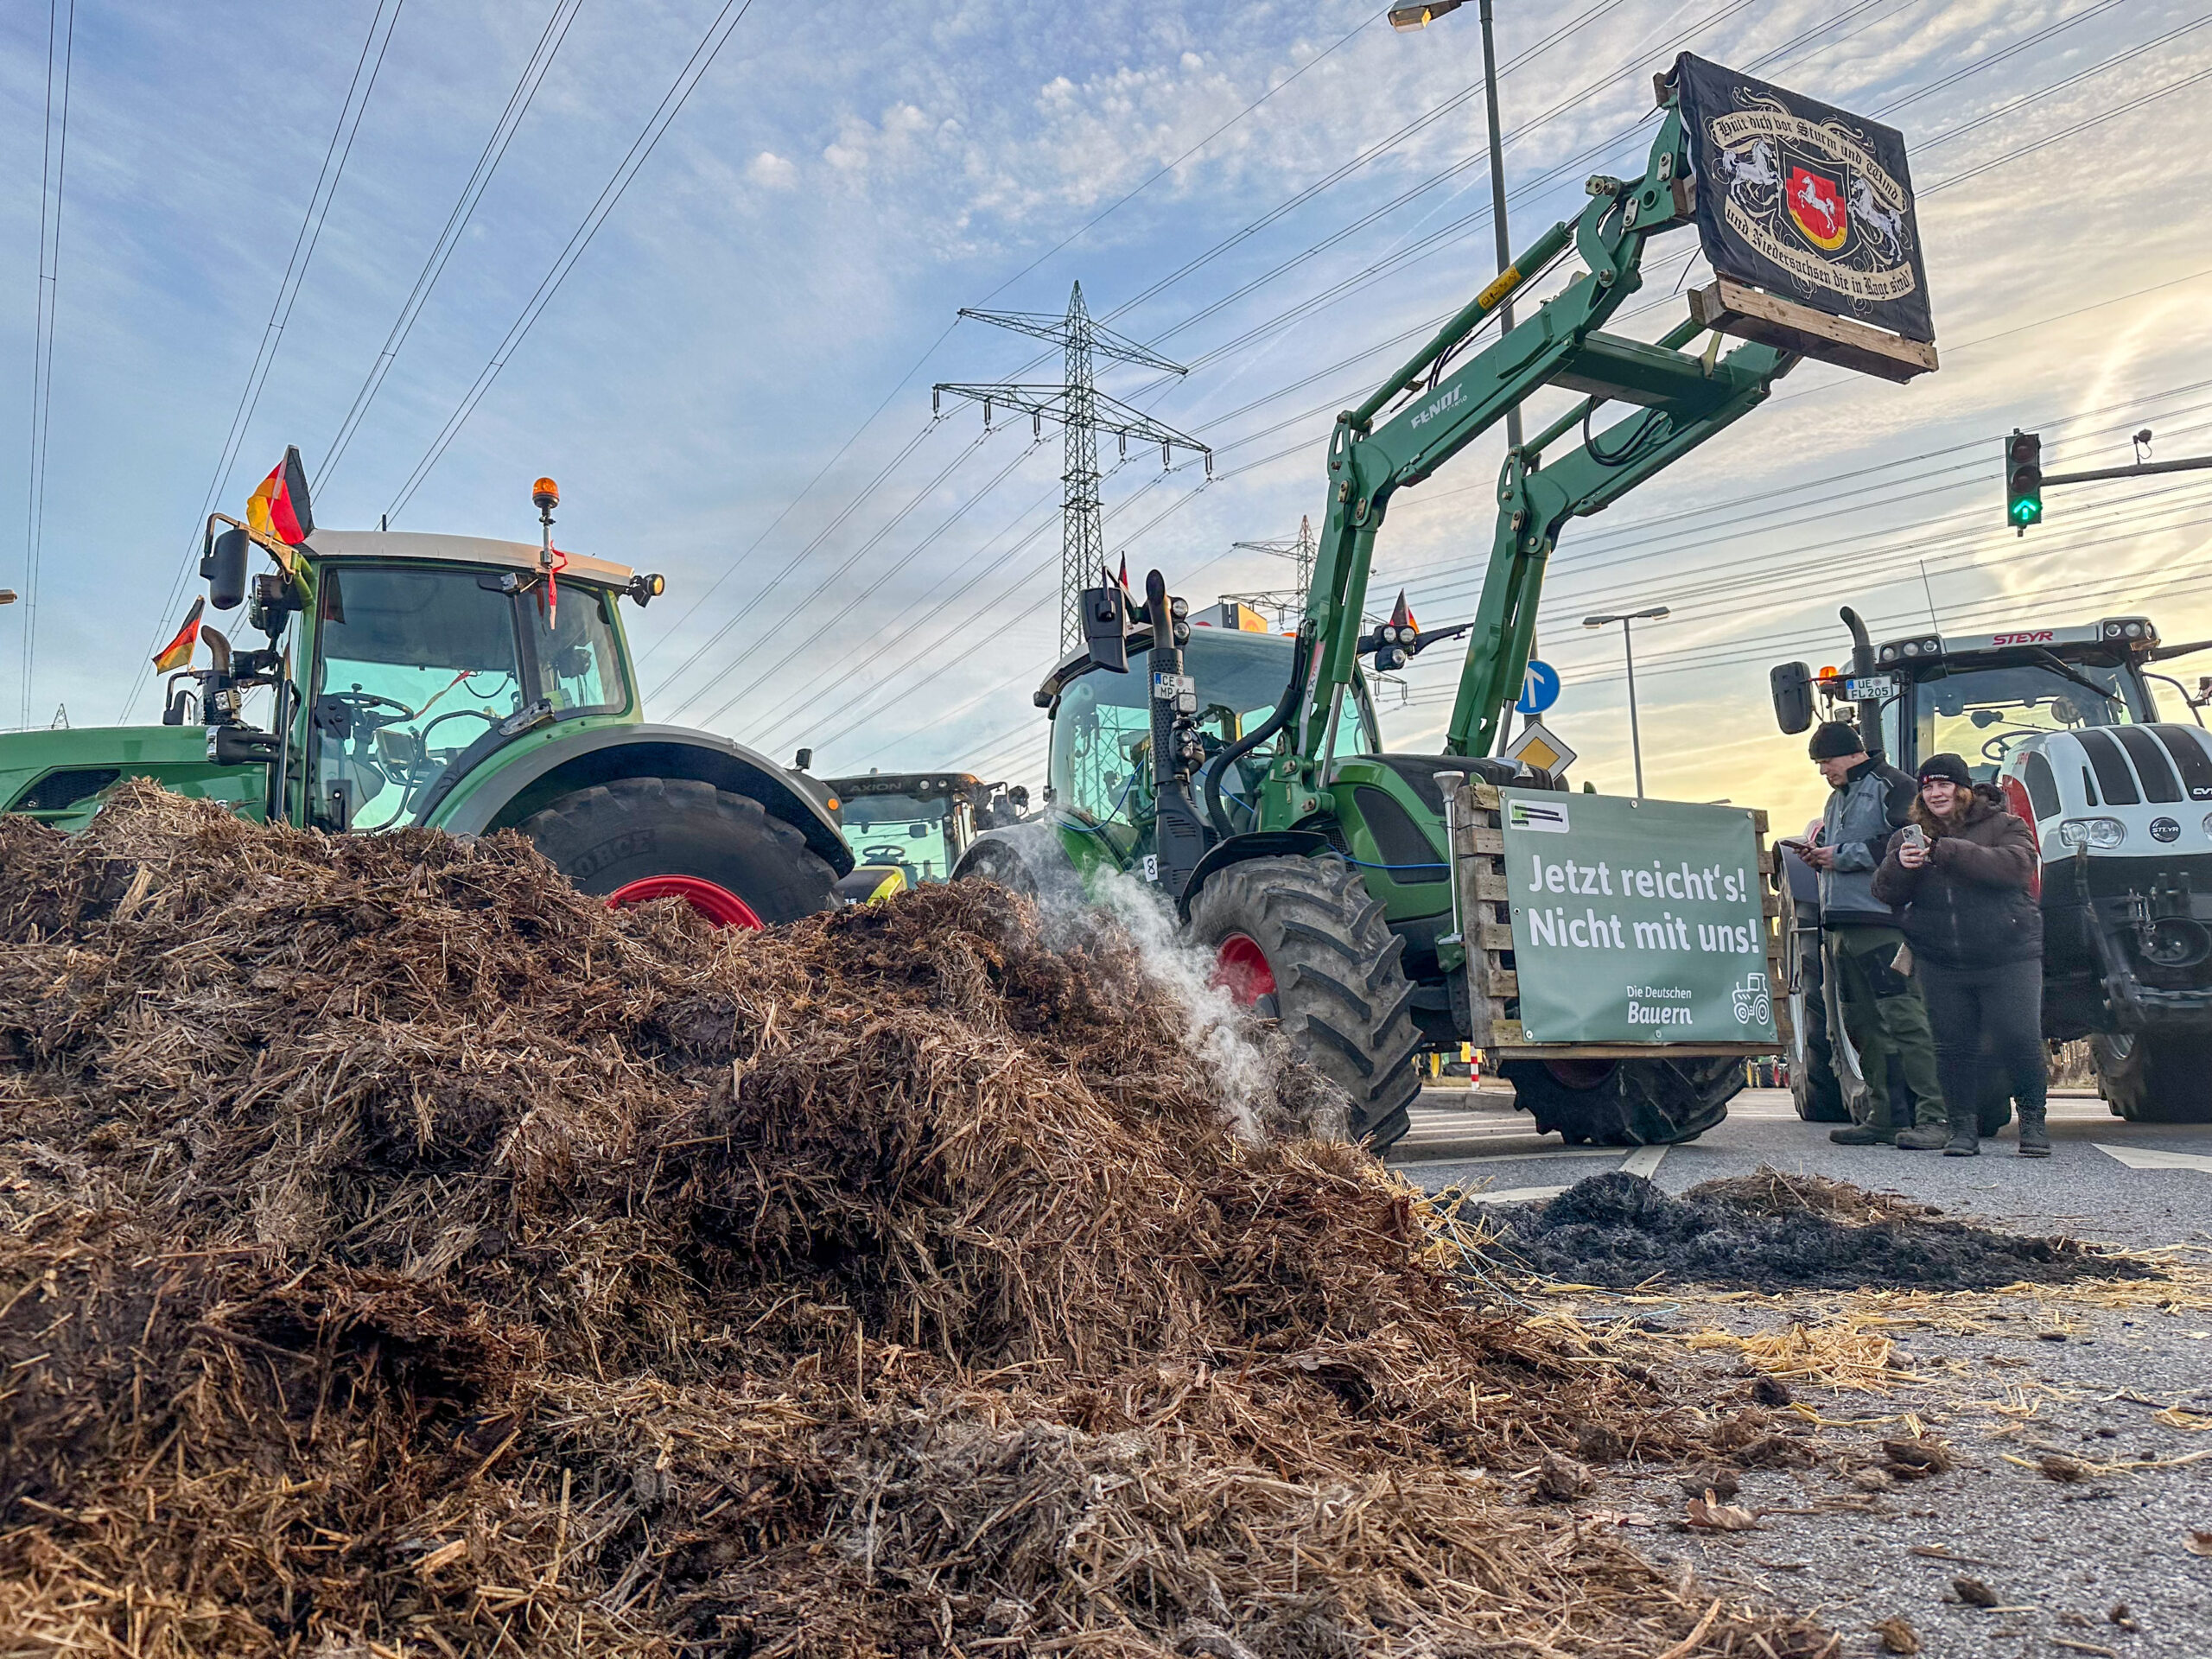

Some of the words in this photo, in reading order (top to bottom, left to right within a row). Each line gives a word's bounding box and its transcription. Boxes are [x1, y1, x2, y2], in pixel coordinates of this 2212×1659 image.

[1747, 114, 1773, 131] dich
[1796, 121, 1837, 151] Sturm
[1840, 145, 1862, 165] und
[1866, 159, 1898, 200] Wind
[1726, 208, 1749, 236] und
[1751, 227, 1831, 284] Niedersachsen
[1833, 269, 1849, 291] die
[1851, 276, 1862, 295] in
[1864, 276, 1890, 299] Rage
[1890, 269, 1913, 294] sind!
[1410, 382, 1463, 429] FENDT
[1992, 631, 2054, 646] STEYR
[1162, 675, 1175, 687] CE
[1858, 679, 1872, 689] UE
[1851, 690, 1866, 699] FL
[1867, 687, 1889, 697] 205
[849, 782, 902, 792] AXION
[2152, 825, 2179, 834] STEYR
[1147, 858, 1155, 874] 8
[1529, 855, 1613, 895] Jetzt
[1528, 906, 1625, 950] Nicht
[1632, 912, 1691, 950] mit
[1697, 918, 1759, 954] uns!
[1626, 985, 1643, 998] Die
[1645, 986, 1692, 999] Deutschen
[1627, 1001, 1694, 1025] Bauern
